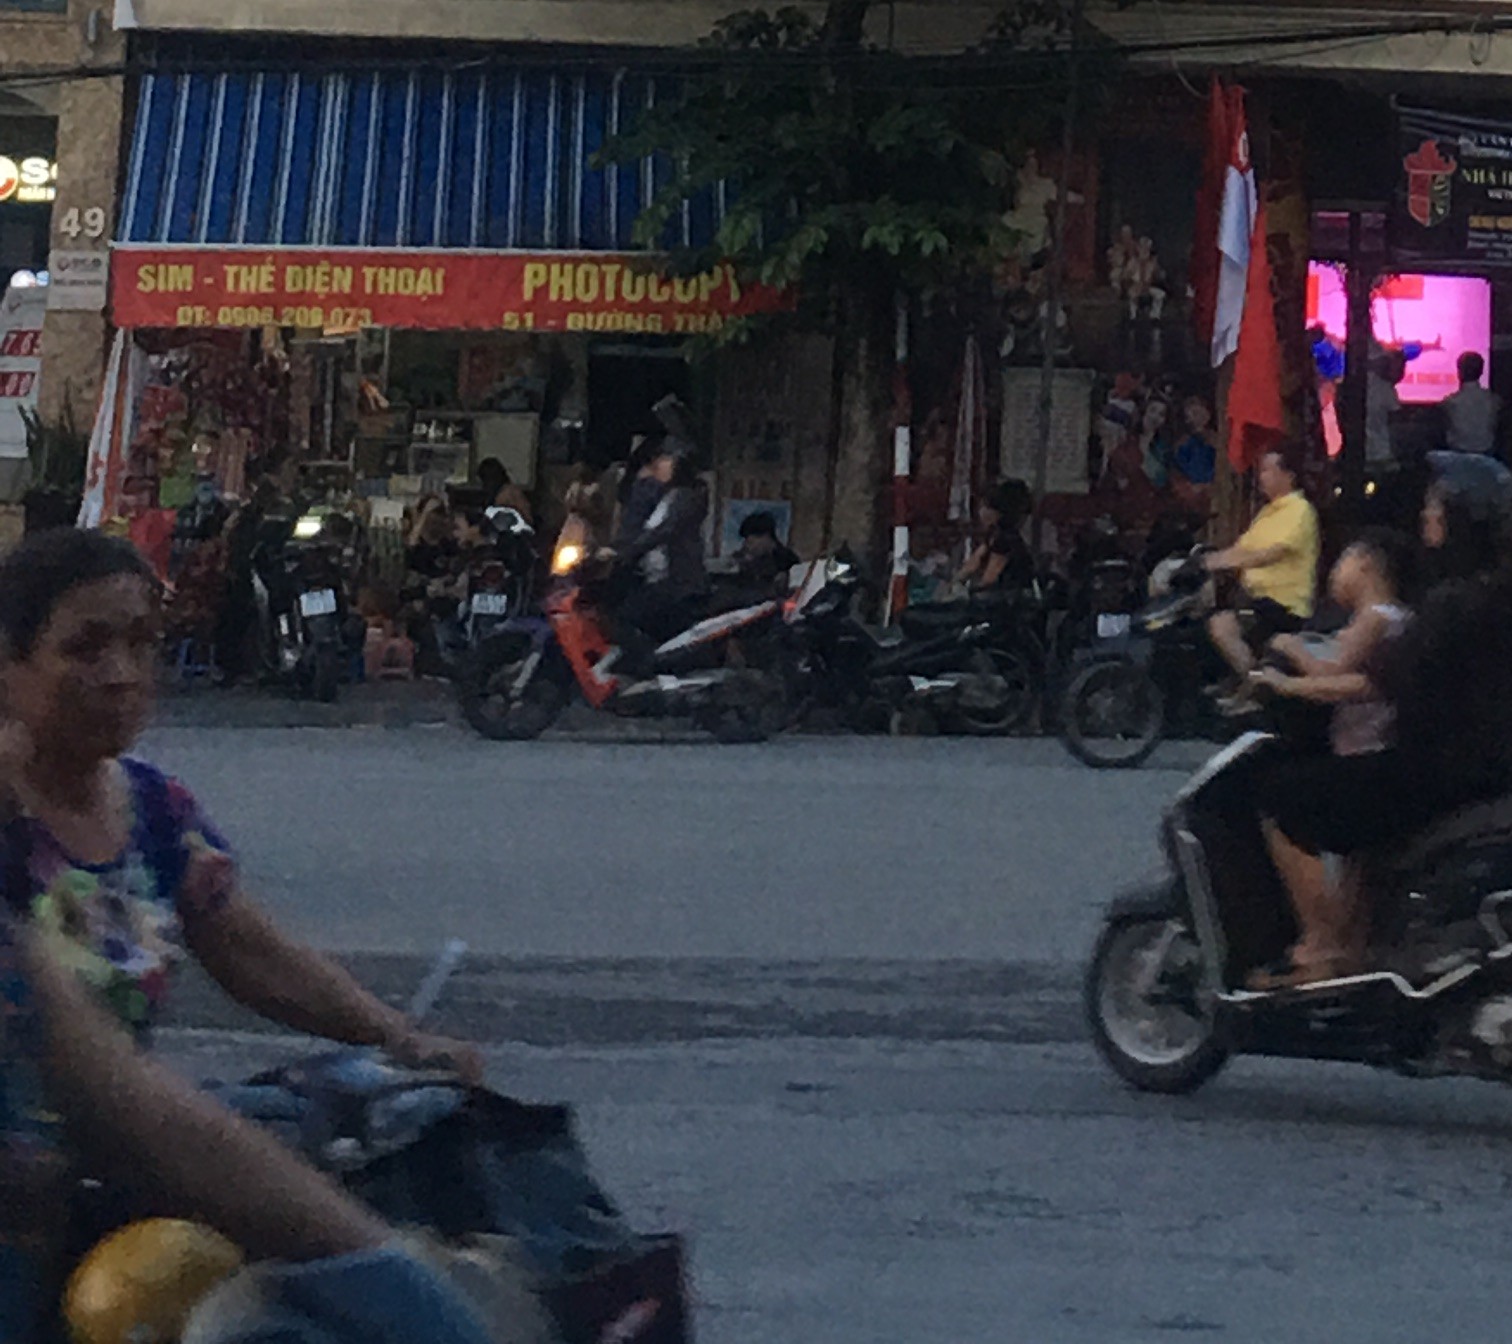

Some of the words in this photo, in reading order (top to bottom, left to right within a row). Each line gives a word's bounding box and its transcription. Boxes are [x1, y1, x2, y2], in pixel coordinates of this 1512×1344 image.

[60, 206, 105, 238] 49
[136, 263, 194, 293] SIM
[285, 260, 353, 299] ĐIỆN
[361, 265, 446, 301] THOẠI
